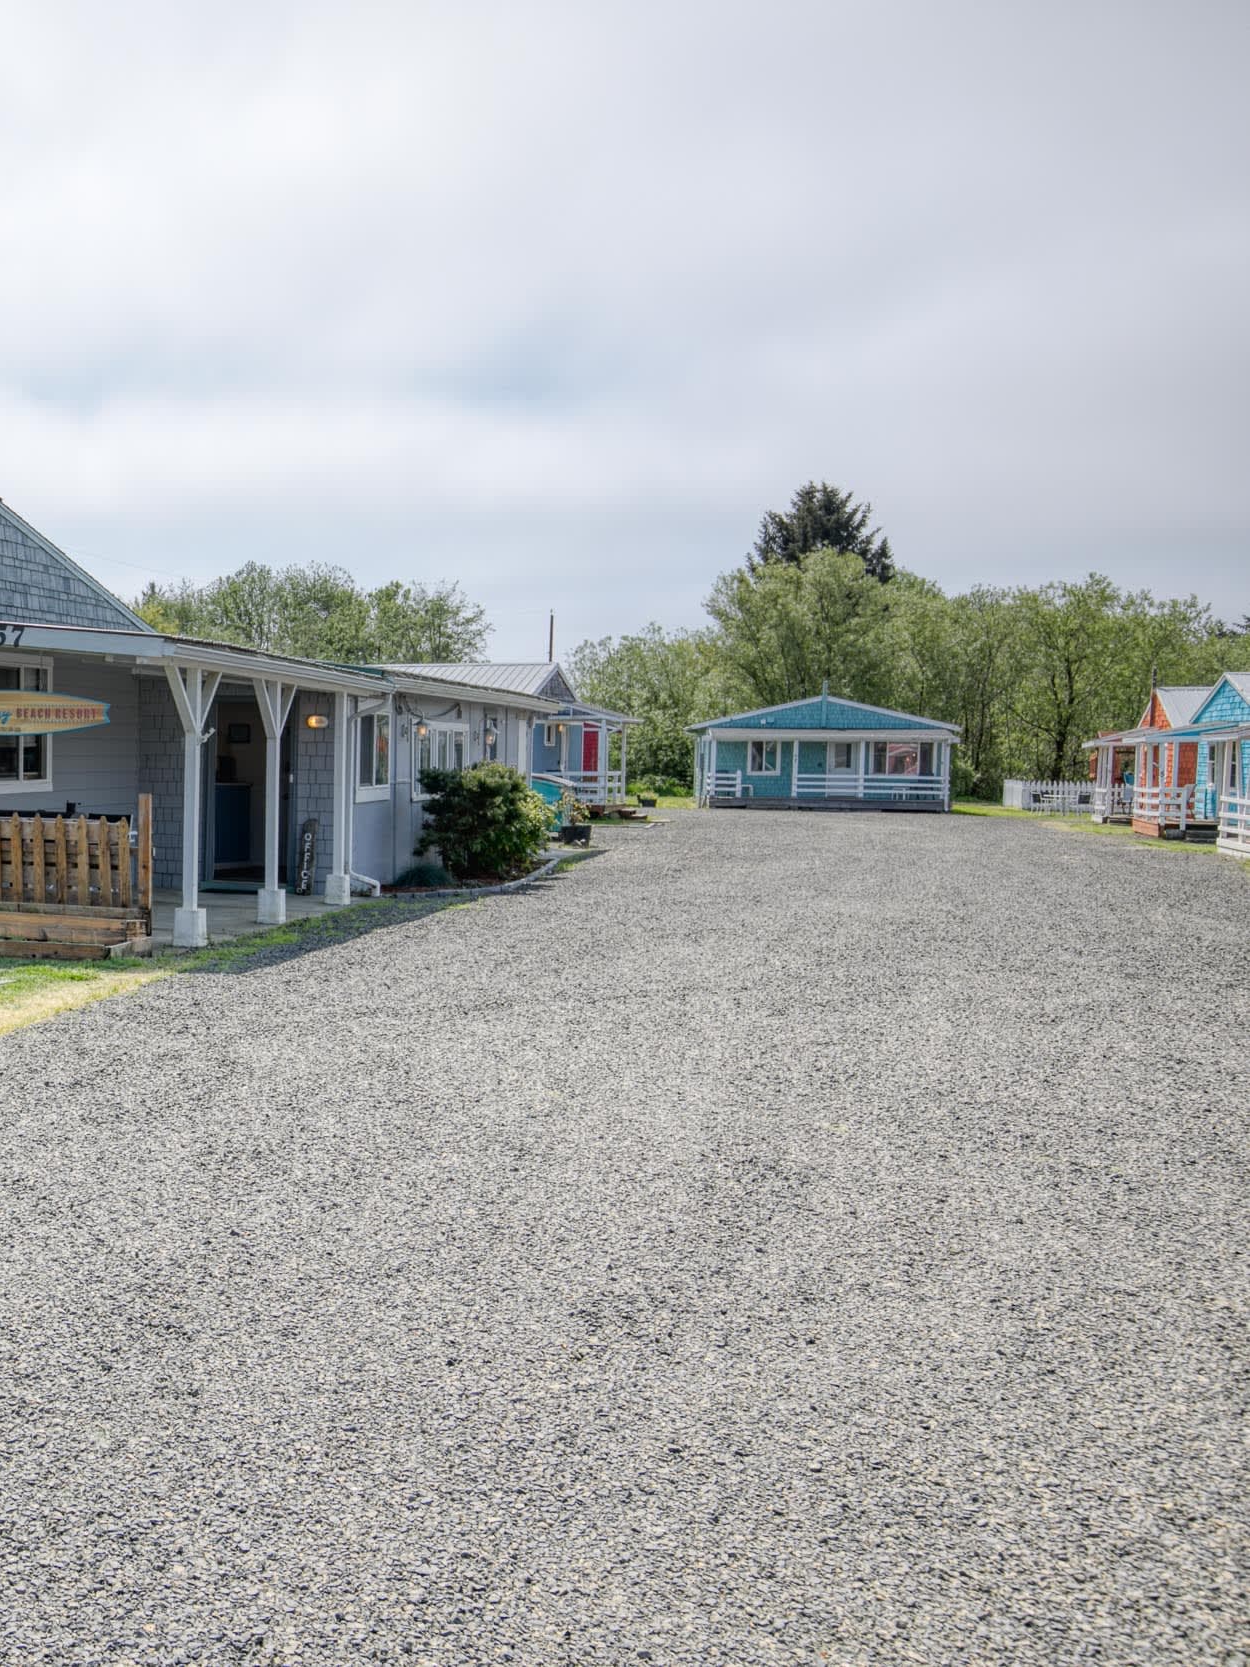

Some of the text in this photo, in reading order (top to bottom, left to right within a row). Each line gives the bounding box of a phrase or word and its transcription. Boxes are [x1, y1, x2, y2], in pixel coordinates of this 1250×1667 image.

[16, 707, 51, 719] BEACH
[55, 707, 96, 719] RESORT
[301, 833, 312, 890] OFFICE
